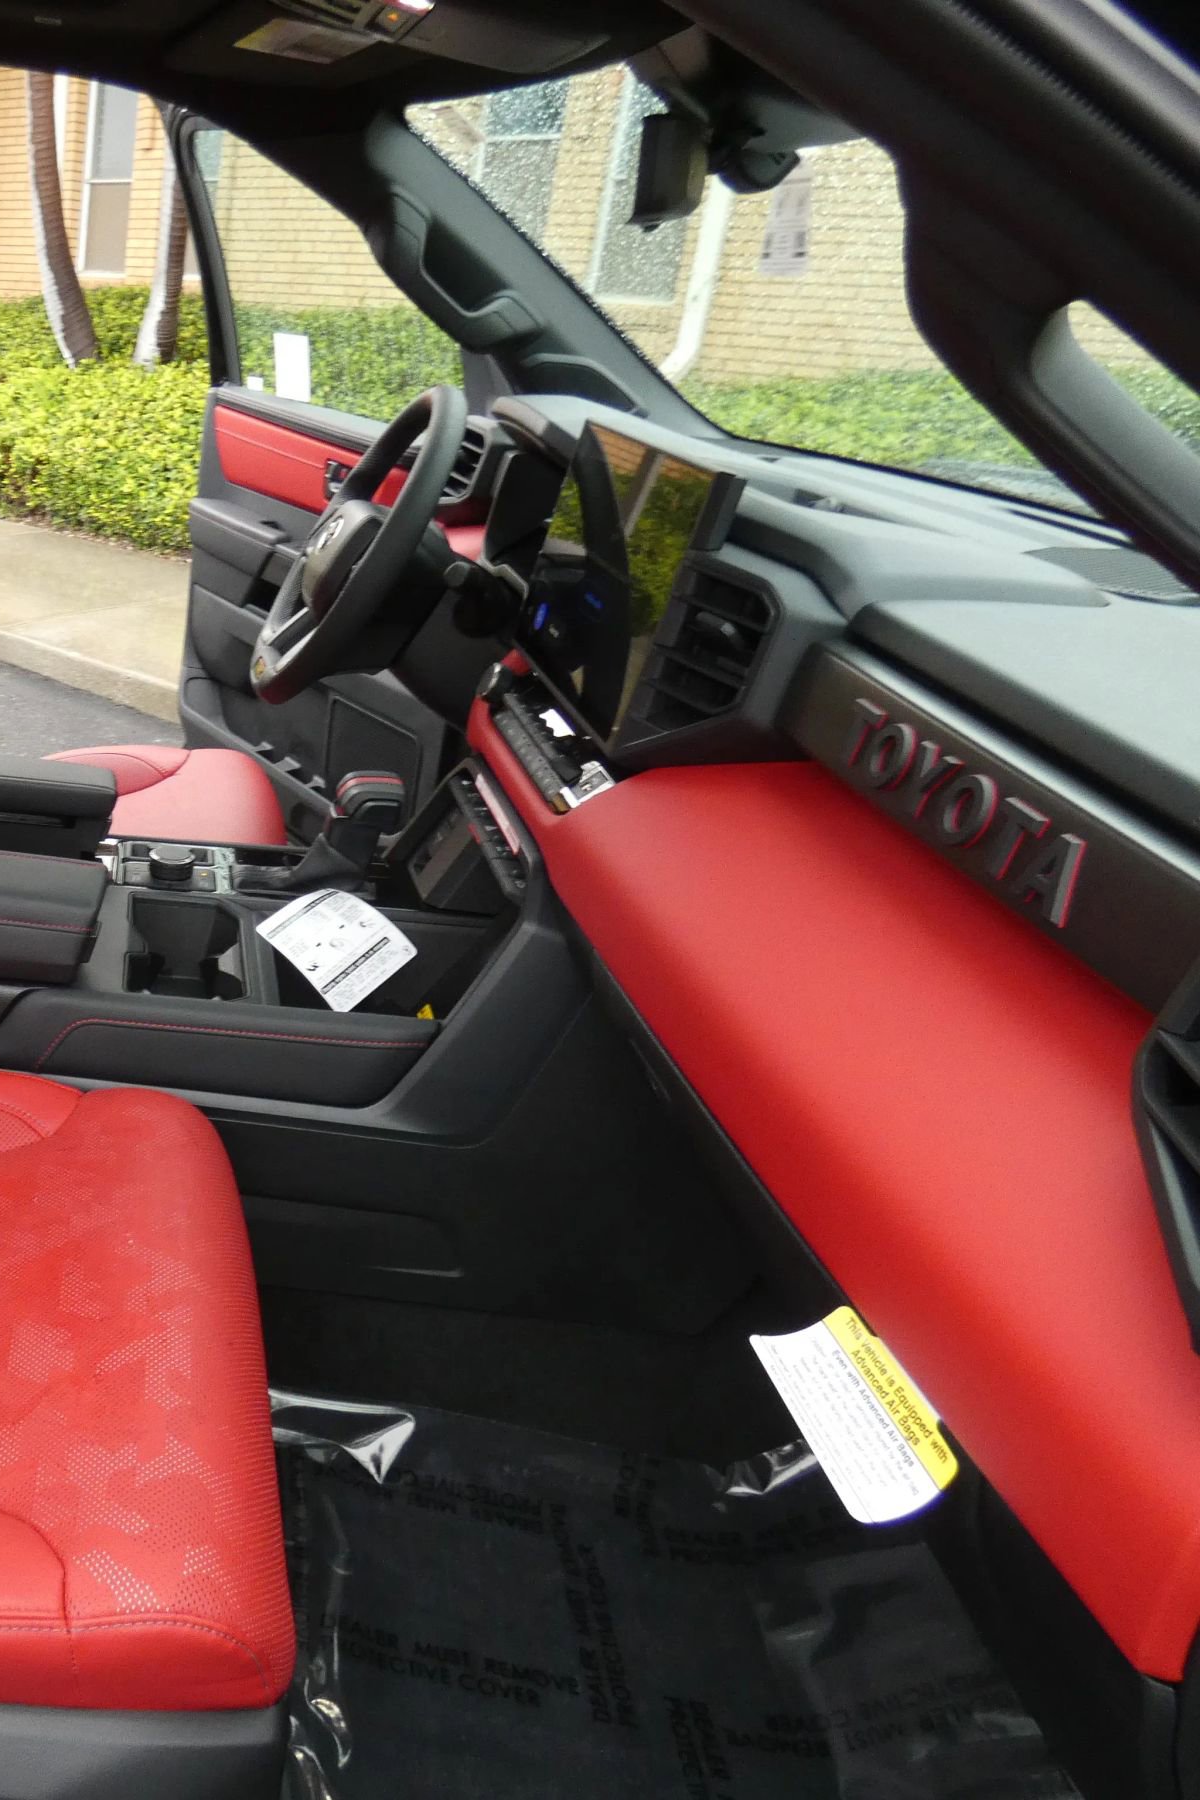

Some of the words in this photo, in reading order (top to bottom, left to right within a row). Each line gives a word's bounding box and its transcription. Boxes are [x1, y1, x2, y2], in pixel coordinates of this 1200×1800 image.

[846, 698, 1087, 929] TOYOTA
[831, 1349, 848, 1370] Even
[846, 1370, 860, 1388] with
[858, 1388, 890, 1430] Advanced
[886, 1429, 899, 1443] Air
[896, 1441, 915, 1468] Bags
[845, 1316, 863, 1341] This
[860, 1338, 888, 1376] Vehicle
[885, 1374, 896, 1388] is
[892, 1385, 933, 1439] Equipped
[929, 1437, 948, 1464] with
[850, 1348, 890, 1400] Advanced
[885, 1398, 901, 1416] Air
[897, 1414, 921, 1447] Bags
[413, 1640, 471, 1668] MUST
[483, 1656, 581, 1696] REMOVE
[457, 1672, 542, 1708] COVER
